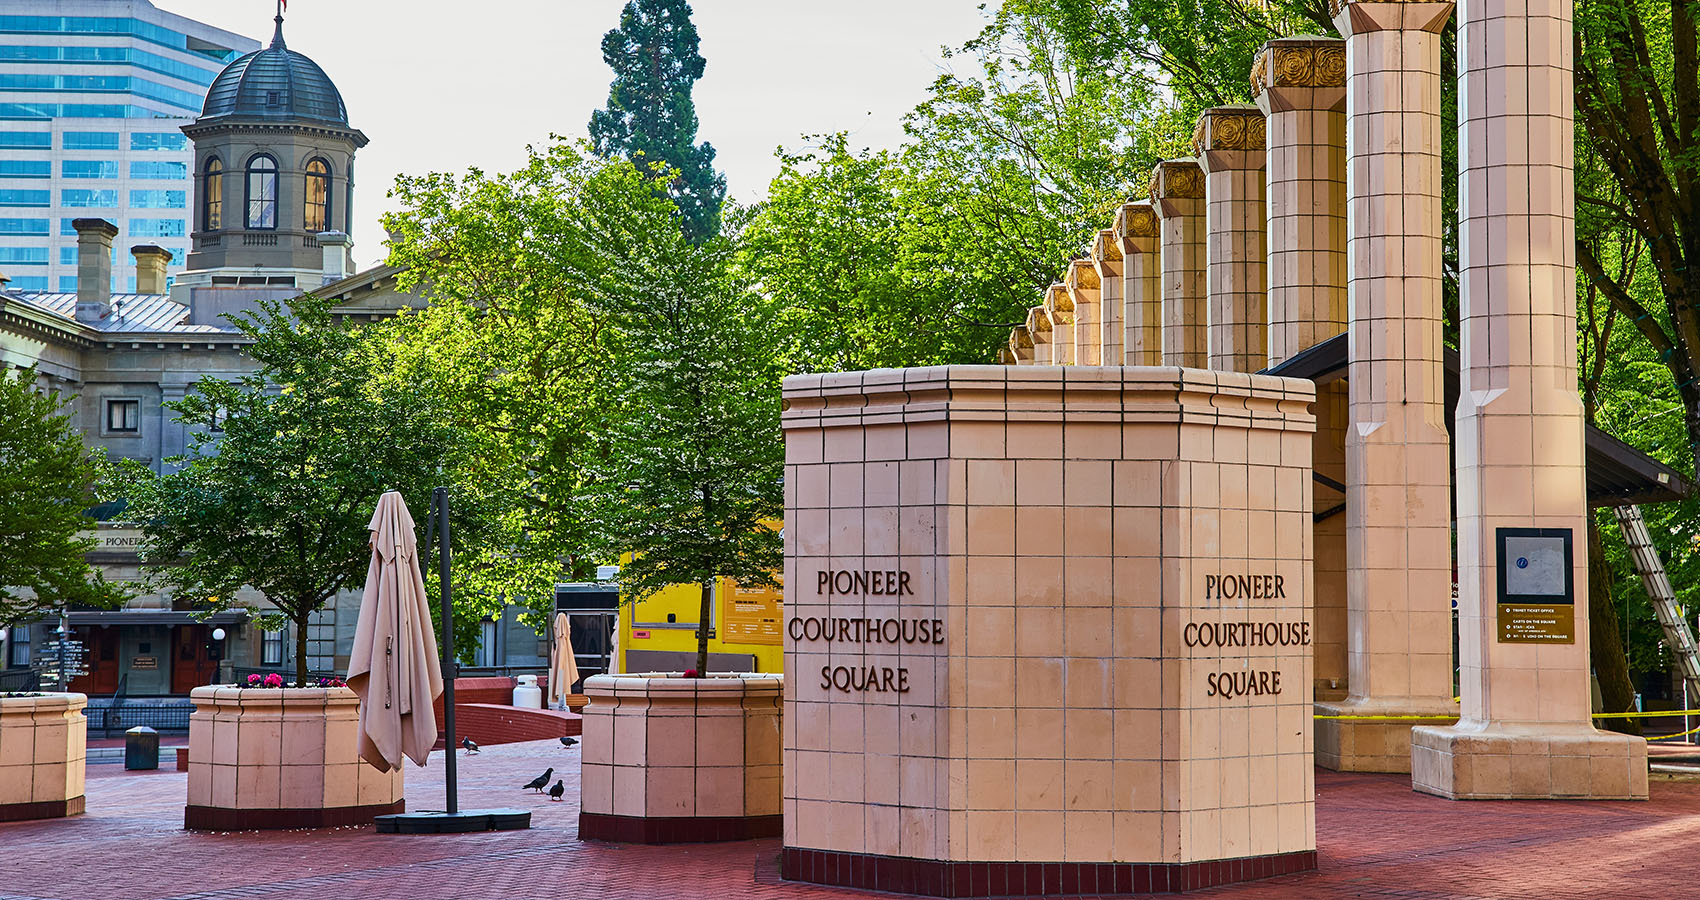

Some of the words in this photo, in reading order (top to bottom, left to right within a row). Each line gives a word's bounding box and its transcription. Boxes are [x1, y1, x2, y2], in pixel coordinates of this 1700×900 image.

[817, 570, 914, 595] PIONEER
[1206, 575, 1286, 599] PIONEER
[788, 617, 945, 644] COURTHOUSE
[1184, 622, 1311, 647] COURTHOUSE
[820, 665, 910, 693] SQUARE
[1207, 670, 1282, 699] SQUARE
